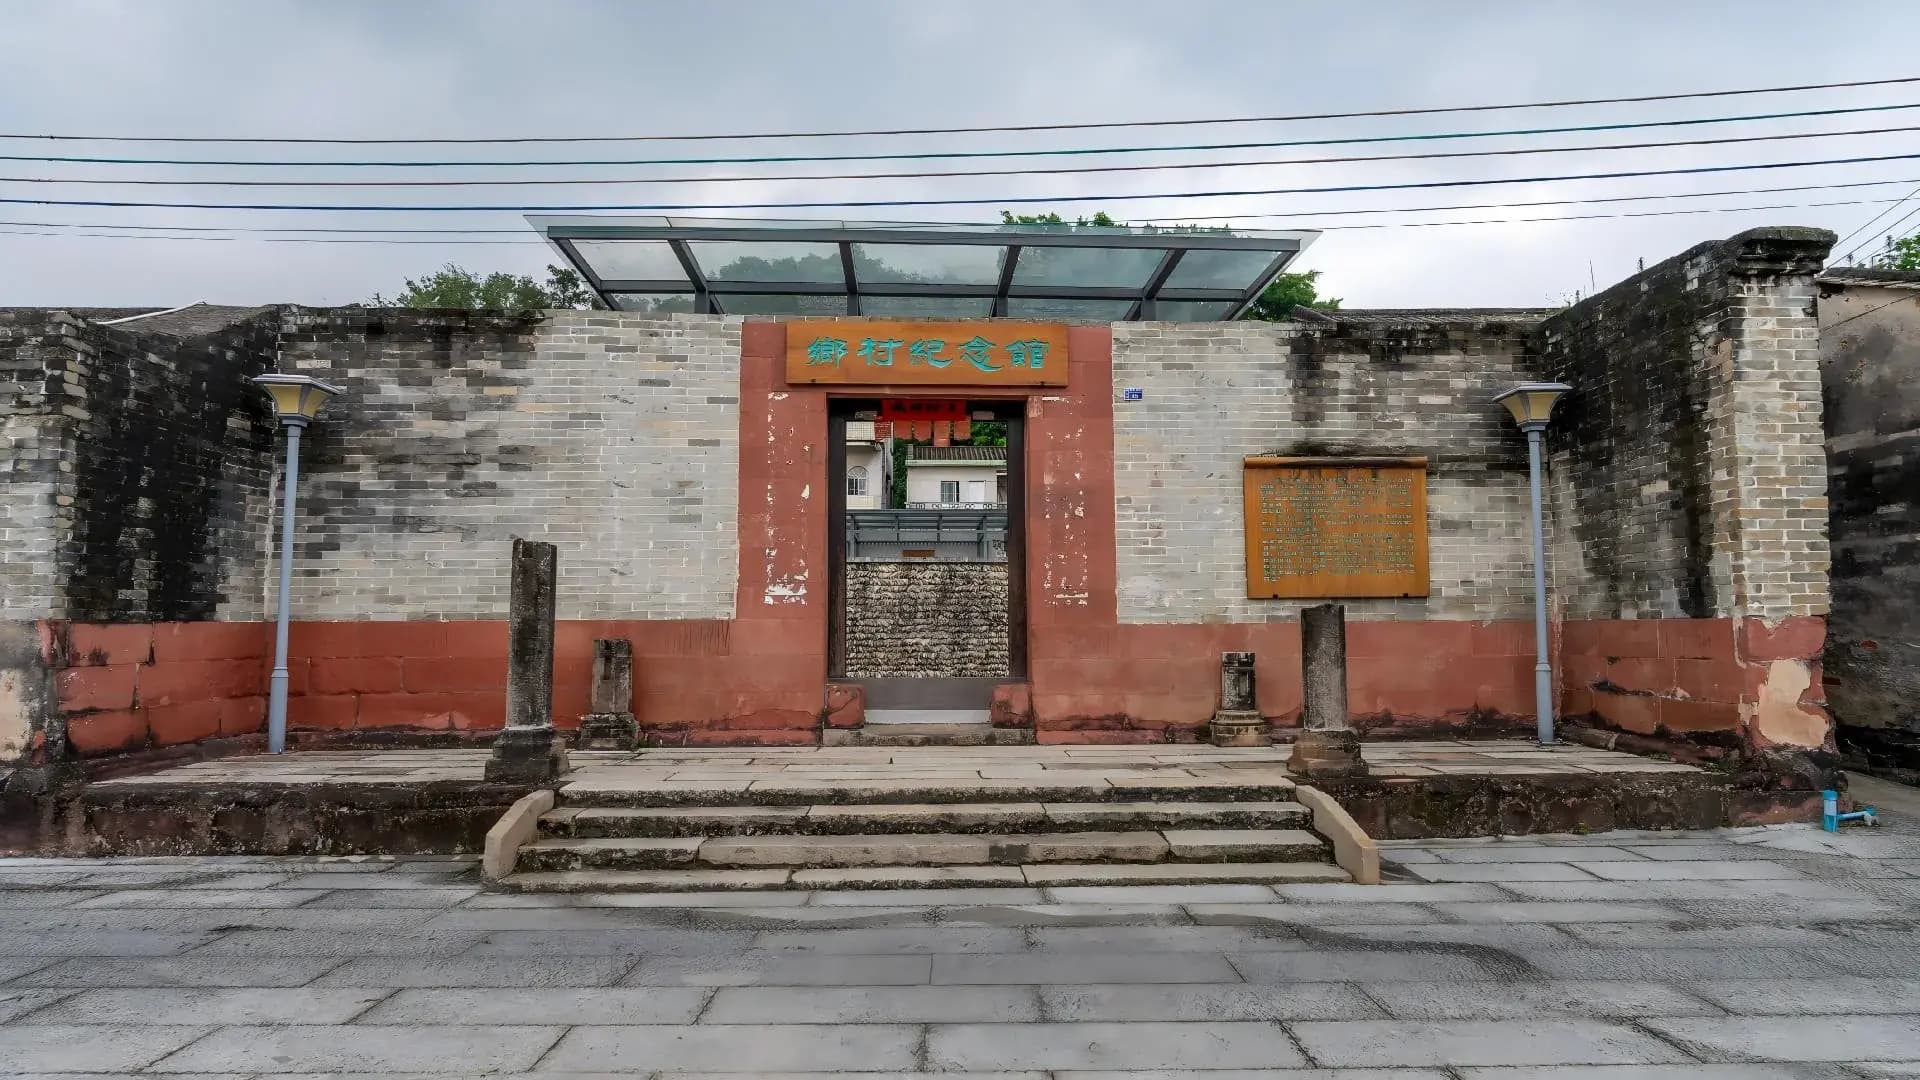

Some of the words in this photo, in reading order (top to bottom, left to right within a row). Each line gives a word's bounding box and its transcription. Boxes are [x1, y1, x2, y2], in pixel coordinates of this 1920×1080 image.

[807, 336, 1049, 372] 鄉村紀念館
